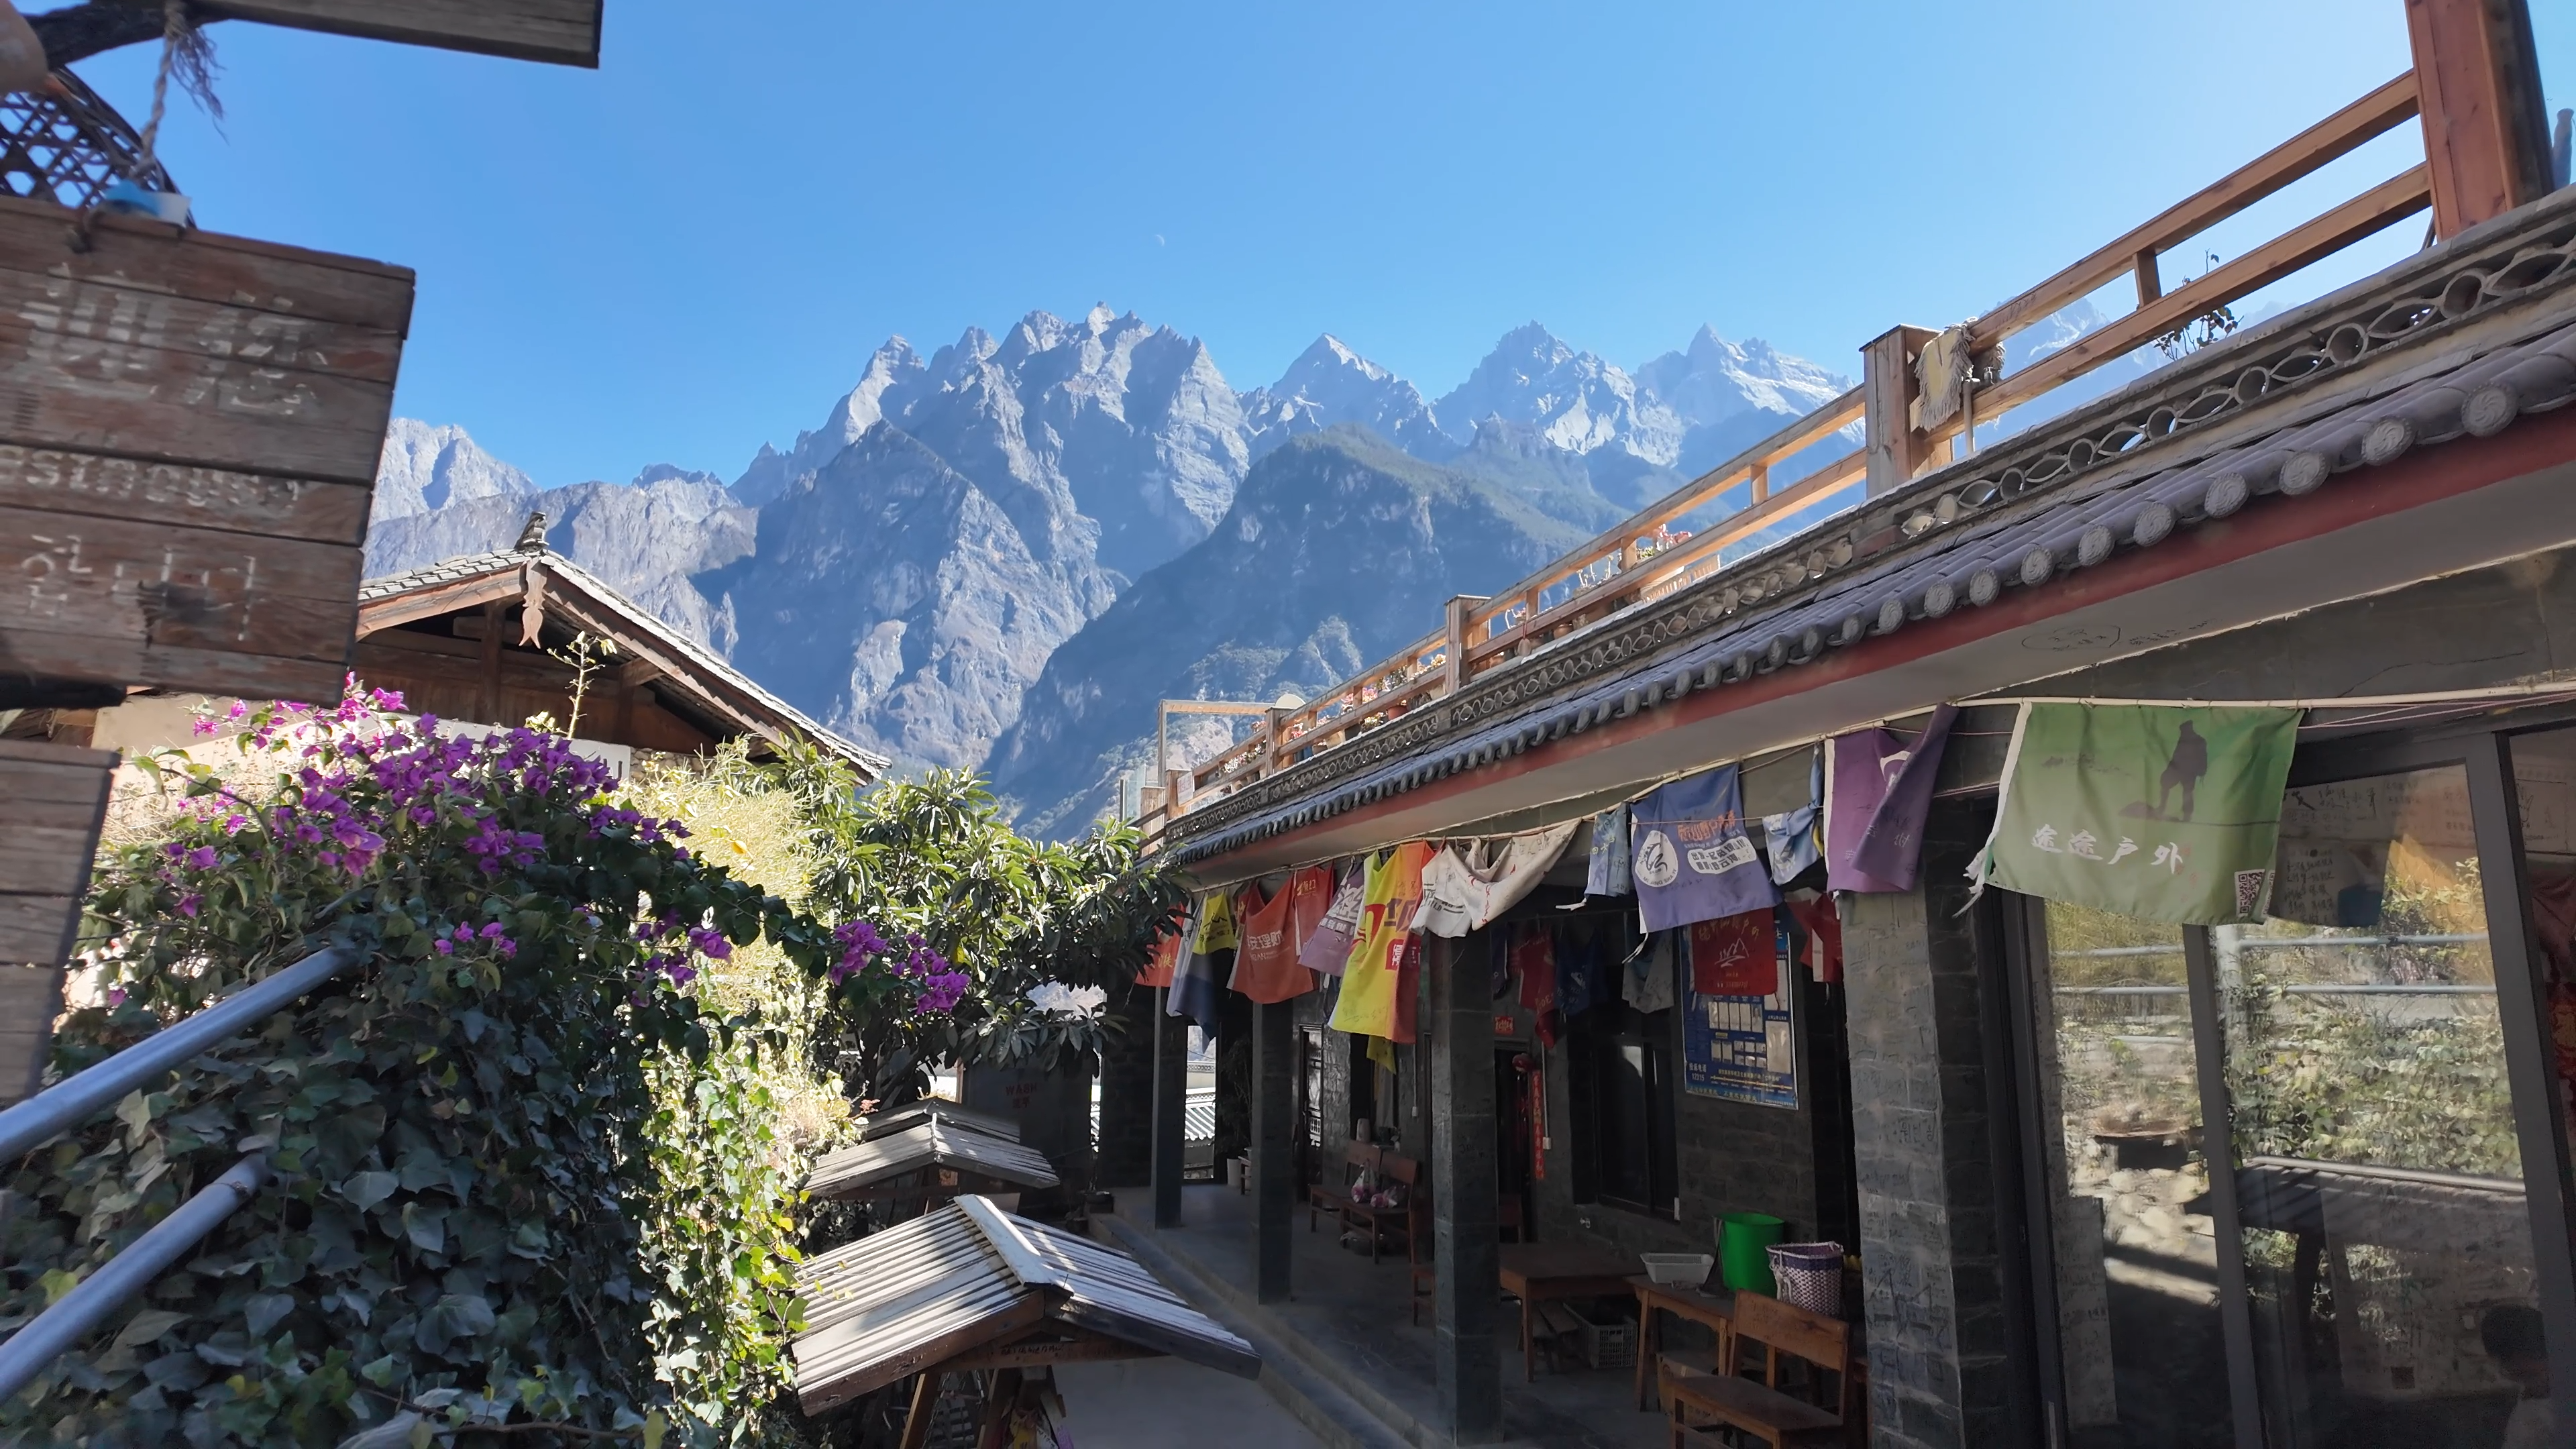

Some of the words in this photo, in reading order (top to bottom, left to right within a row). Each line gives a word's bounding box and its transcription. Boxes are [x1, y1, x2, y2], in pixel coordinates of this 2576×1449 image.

[2031, 824, 2183, 874] 途途户外
[1692, 1073, 1705, 1081] 12315
[1005, 1083, 1037, 1095] WASH
